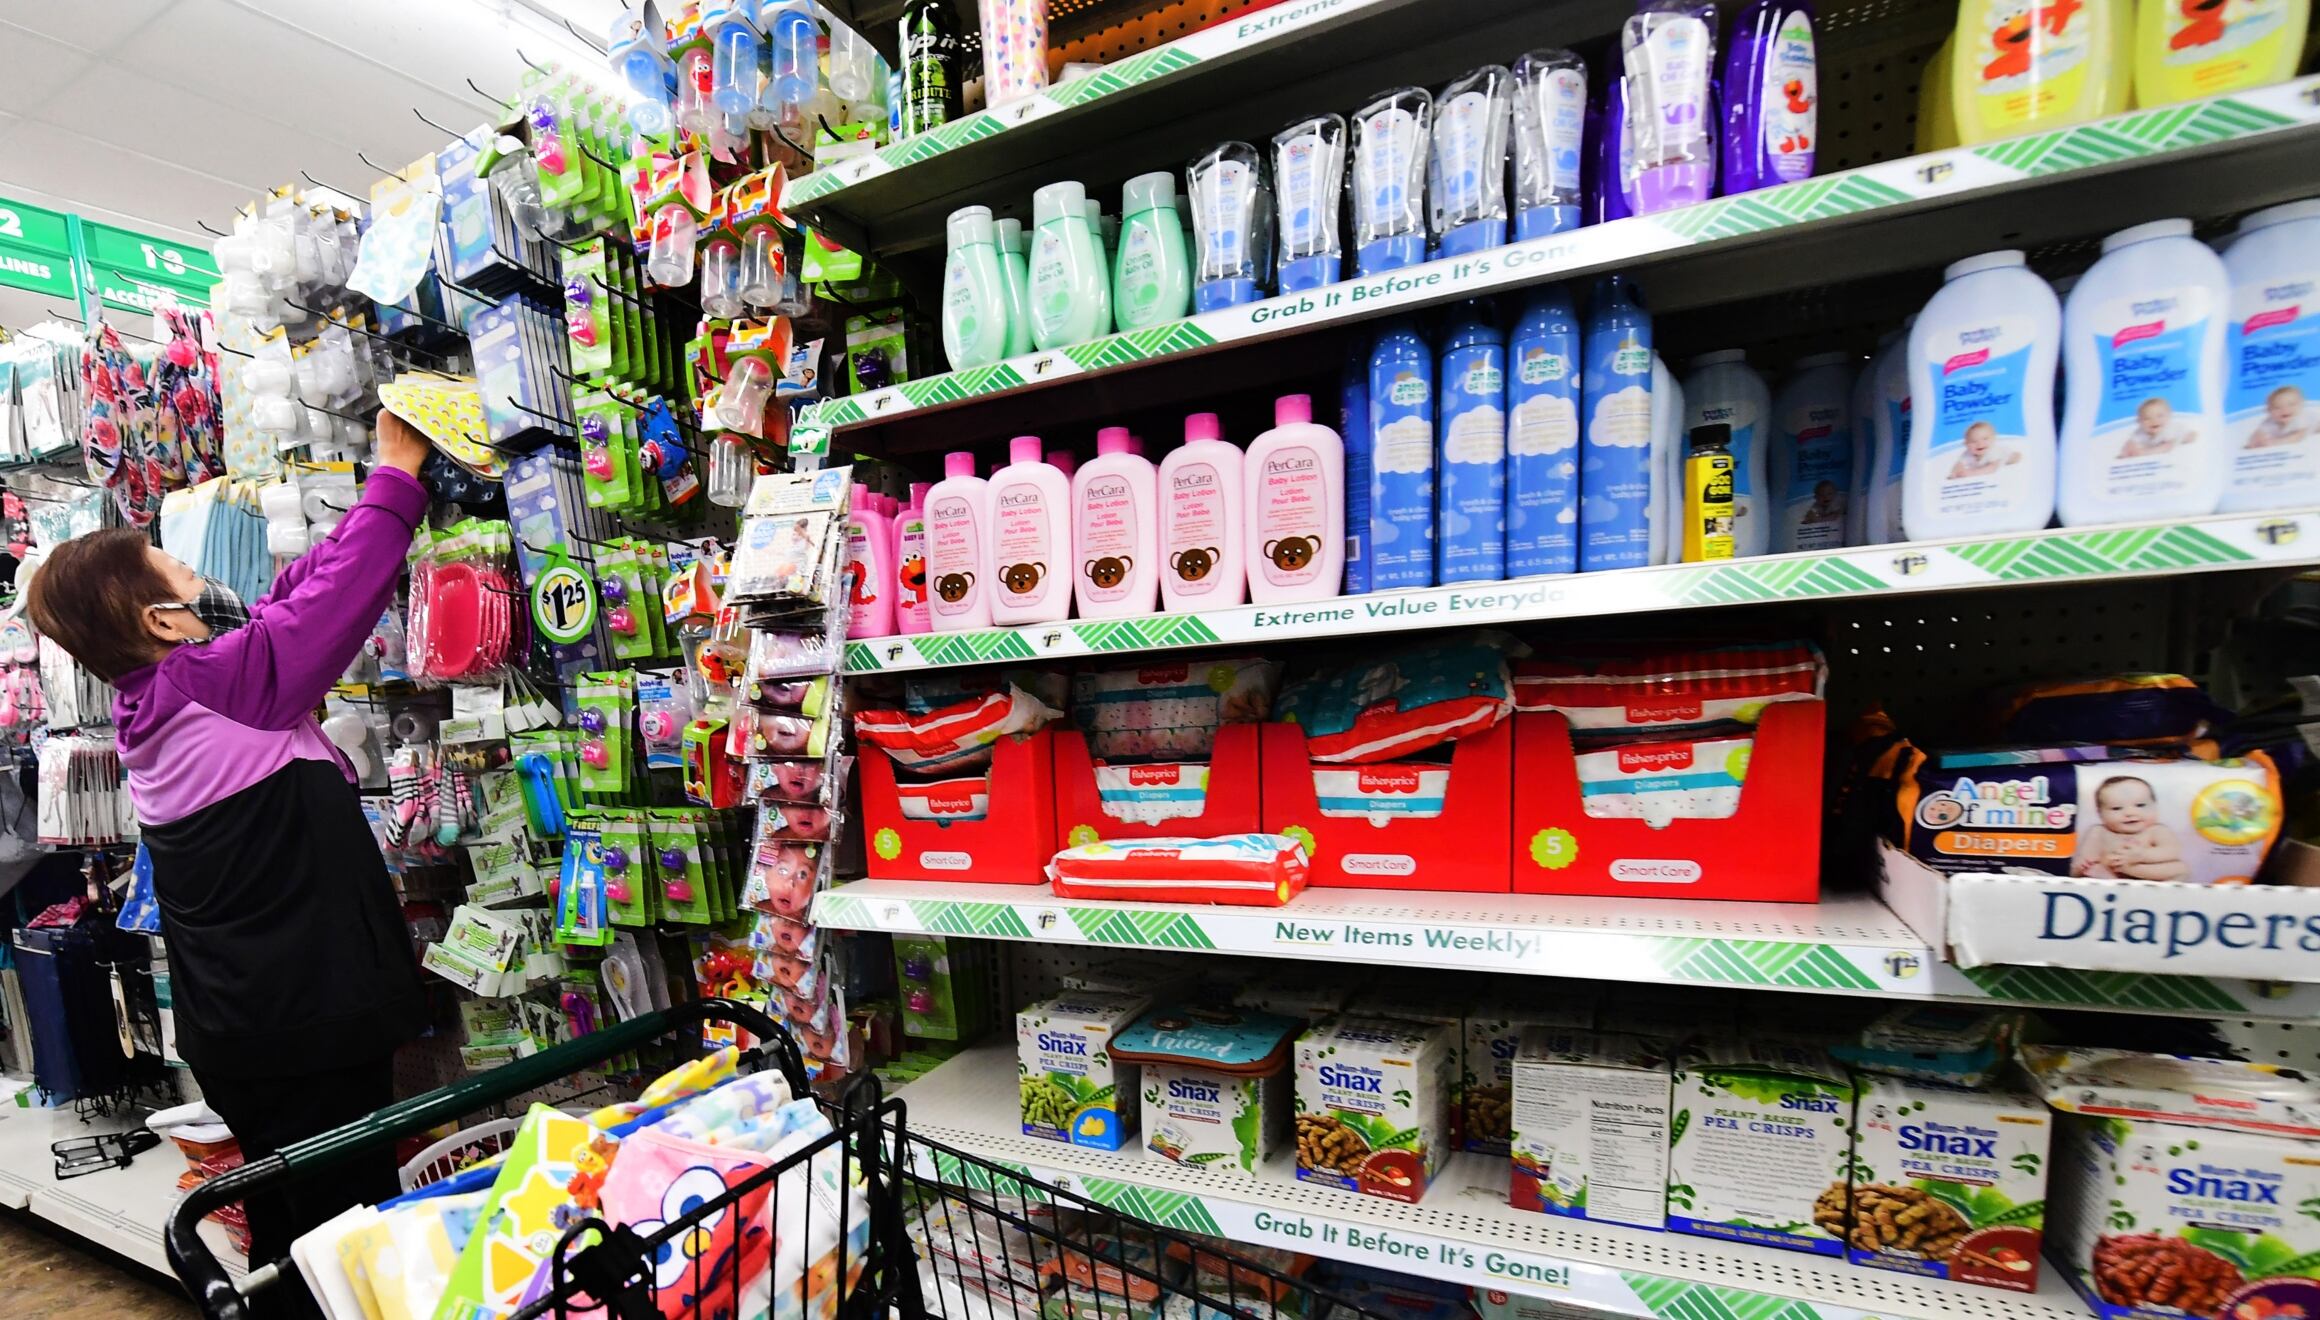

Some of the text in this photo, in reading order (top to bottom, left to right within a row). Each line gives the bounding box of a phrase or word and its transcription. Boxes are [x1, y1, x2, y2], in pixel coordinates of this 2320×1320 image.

[902, 87, 952, 100] RIBUTE
[1251, 298, 1314, 323] Grab
[1325, 292, 1341, 308] It
[1352, 272, 1440, 302] Before
[1453, 259, 1490, 280] It's
[2242, 343, 2299, 361] Baby
[2114, 355, 2166, 373] Baby
[2112, 368, 2188, 389] Powder
[1944, 381, 1991, 399] Baby
[1943, 393, 2014, 414] Powder
[1268, 458, 1313, 473] PerCara
[1174, 474, 1213, 487] PerCara
[1268, 474, 1317, 485] Baby Lotion
[1087, 485, 1125, 498] PerCara
[1174, 488, 1216, 500] Baby Lotion
[1001, 493, 1038, 505] PerCara
[1106, 499, 1129, 508] Lotion
[934, 507, 967, 519] PerCara
[1002, 507, 1042, 517] Baby Lotion
[935, 519, 970, 530] Baby Lotion
[1253, 608, 1354, 627] Extreme
[1365, 598, 1438, 618] Value
[1629, 705, 1698, 718] fisher-price
[1621, 751, 1688, 765] fisher-price
[1131, 769, 1177, 780] fisher-price
[1361, 775, 1416, 787] fisher-price
[1634, 780, 1679, 789] Diapers
[1139, 790, 1170, 799] Diapers
[1956, 779, 2047, 805] Angel
[930, 799, 971, 810] fisher-price
[1369, 800, 1407, 809] Diapers
[1985, 803, 2066, 826] mine
[883, 834, 892, 848] 5
[1547, 836, 1562, 854] 5
[1953, 833, 2057, 853] Diapers
[925, 855, 948, 865] Smart
[1349, 859, 1407, 869] Smart Care
[1619, 865, 1692, 877] Smart Care
[2038, 891, 2320, 958] Diapers
[1275, 922, 1542, 958] New Items Weekly!
[1050, 1030, 1087, 1042] Mum-Mum
[1038, 1034, 1087, 1057] Snax
[1039, 1057, 1089, 1071] PEA CRISPS
[1336, 1063, 1383, 1076] Mum-Mum
[1319, 1066, 1382, 1093] Snax
[1168, 1080, 1220, 1103] Snax
[1322, 1094, 1386, 1110] PEA CRISPS
[1592, 1100, 1664, 1115] Nutrition Facts
[1780, 1093, 1838, 1113] Snax
[1168, 1104, 1221, 1118] PEA CRISPS
[1714, 1108, 1757, 1119] PLANT
[1650, 1130, 1663, 1138] 45
[1704, 1116, 1816, 1139] PEA CRISPS
[1898, 1125, 1997, 1159] Snax
[1900, 1159, 2000, 1179] PEA CRISPS
[2166, 1168, 2281, 1205] Snax
[2168, 1206, 2282, 1227] PEA CRISPS
[1255, 1212, 1570, 1285] Grab It Before It's Gone!
